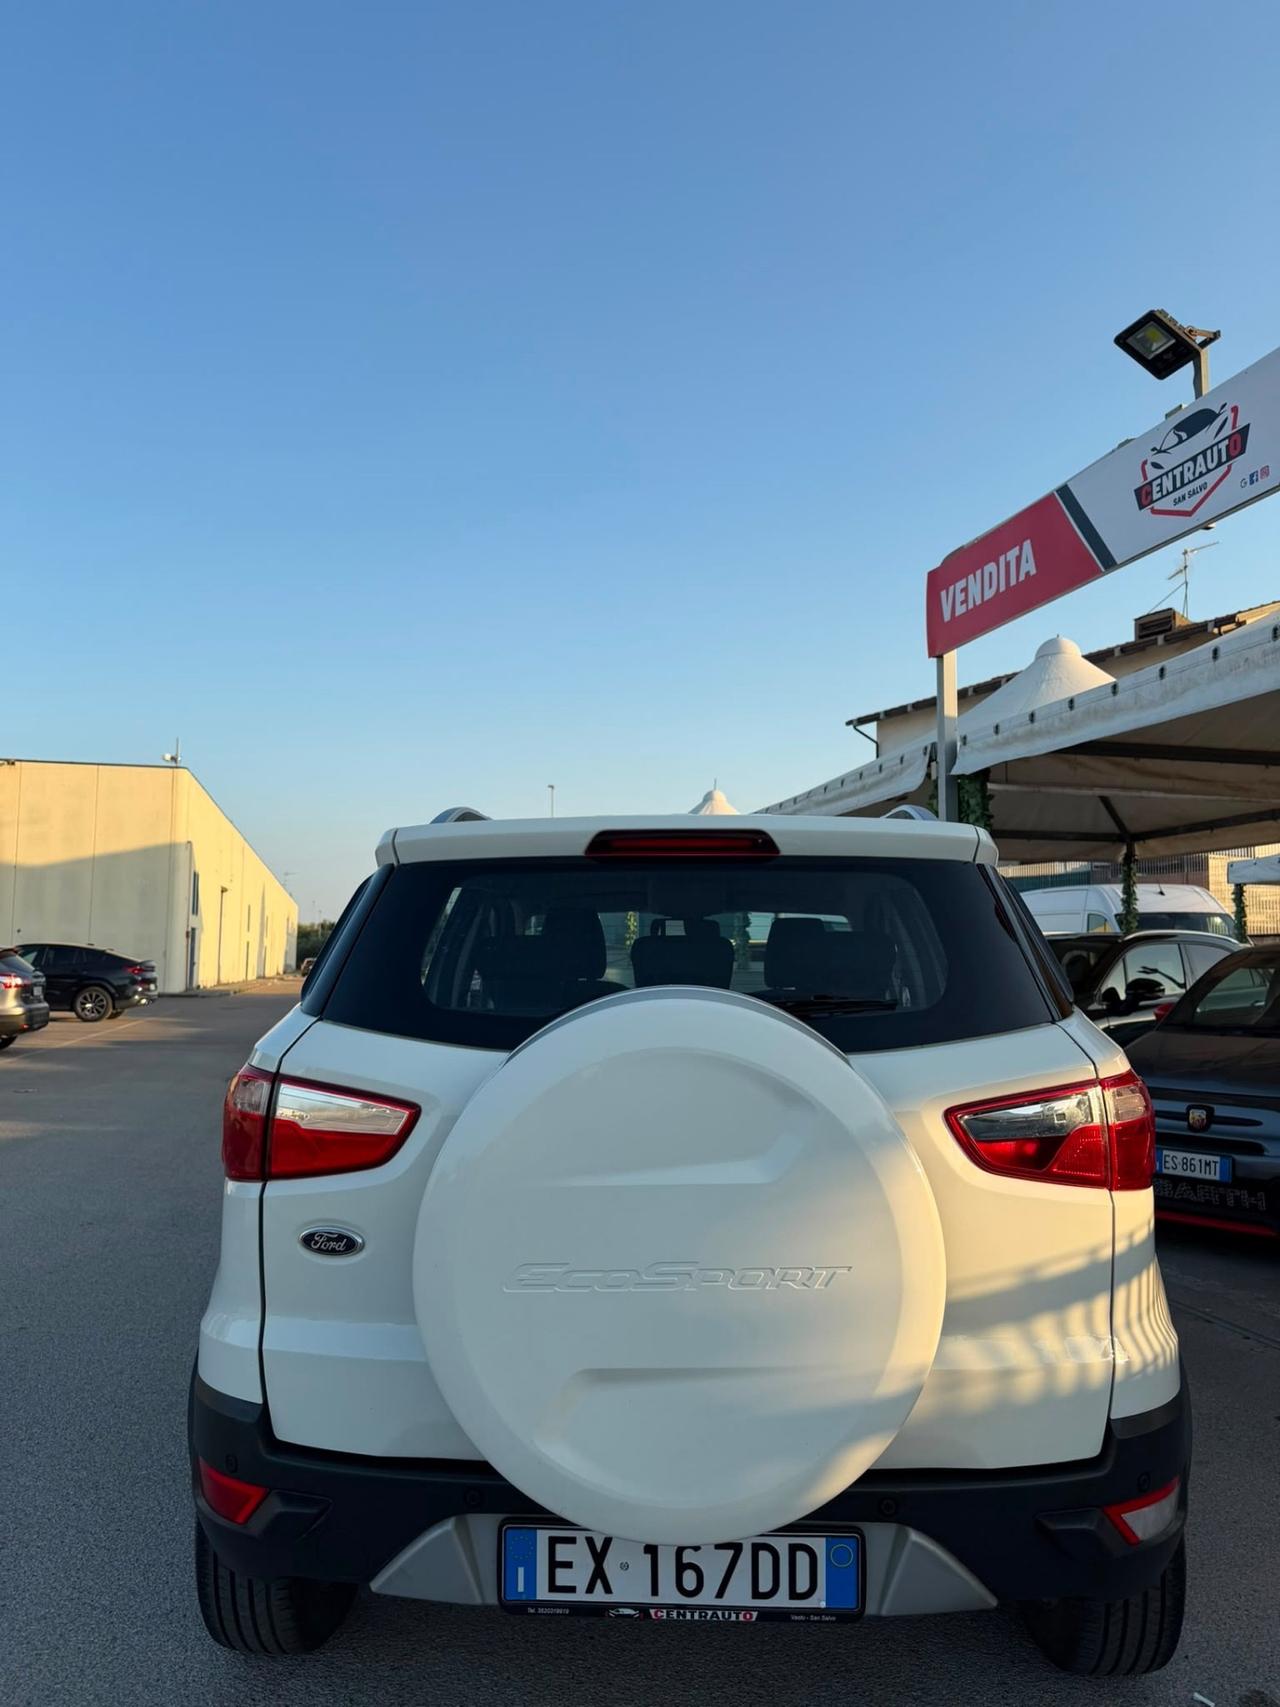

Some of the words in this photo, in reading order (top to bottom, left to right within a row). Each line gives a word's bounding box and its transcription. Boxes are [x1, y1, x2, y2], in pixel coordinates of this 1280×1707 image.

[1139, 432, 1242, 508] CENTRAUTO
[1172, 491, 1187, 507] SAN
[1187, 481, 1208, 500] SALVO
[939, 538, 1037, 624] VENDITA
[1163, 1153, 1178, 1171] ES
[1181, 1157, 1220, 1177] 861MT
[310, 1232, 347, 1251] Ford
[547, 1535, 613, 1595] EX
[643, 1541, 818, 1601] 167DD
[653, 1609, 753, 1621] CENTRAUTO
